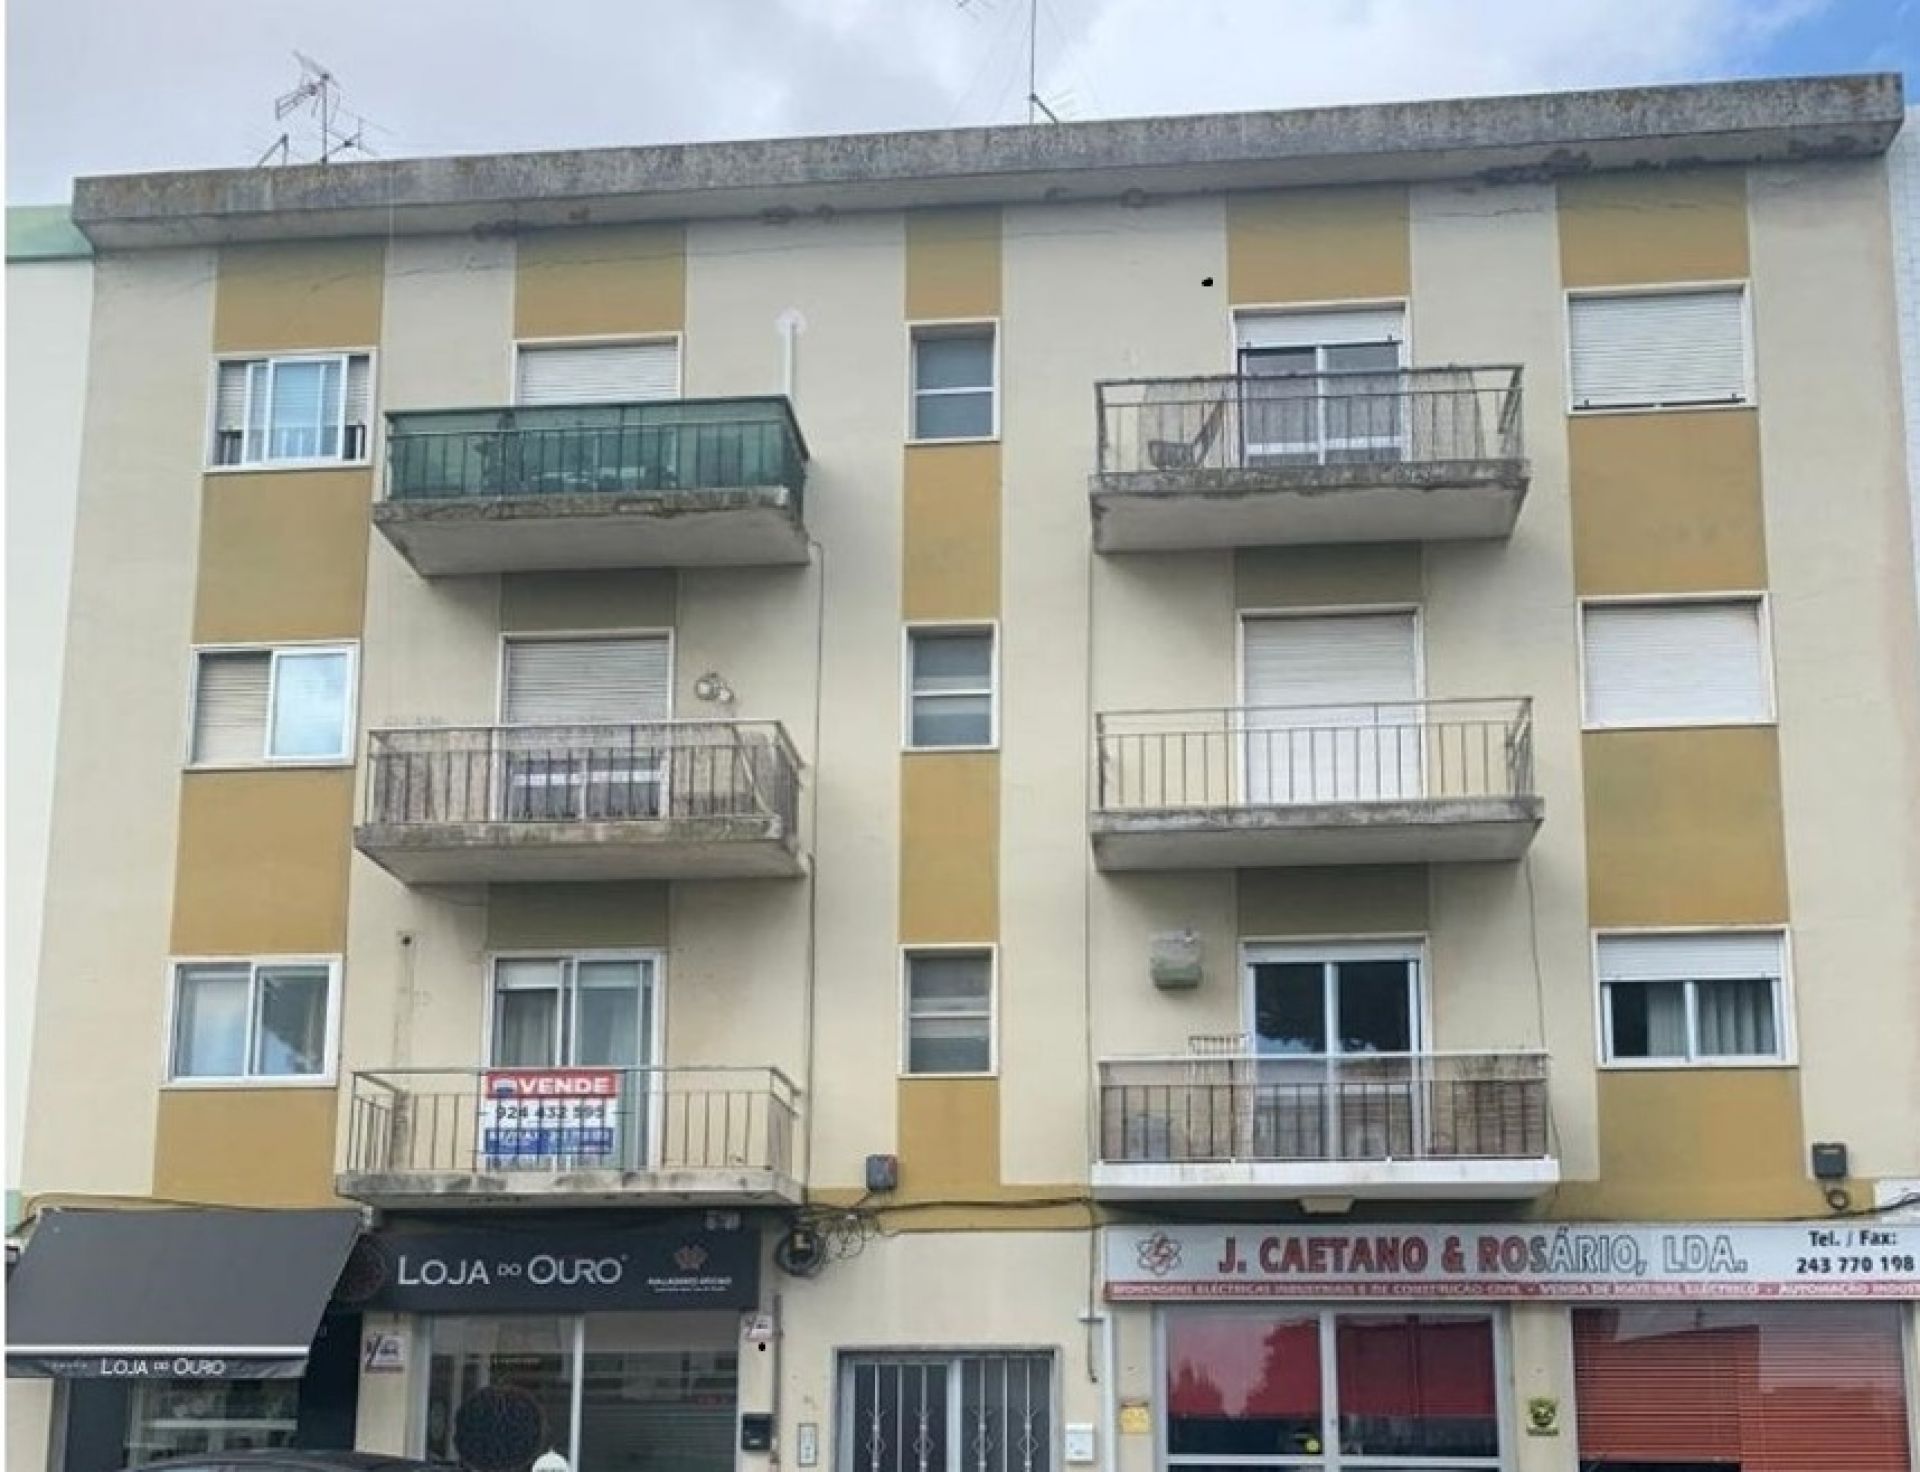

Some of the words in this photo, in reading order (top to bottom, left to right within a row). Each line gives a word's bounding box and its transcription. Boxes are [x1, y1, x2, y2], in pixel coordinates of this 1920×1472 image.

[519, 1077, 610, 1095] VENDE
[1807, 1230, 1840, 1246] Tel.
[1218, 1236, 1247, 1273] J.
[1259, 1235, 1429, 1274] CAETANO
[1441, 1235, 1465, 1273] &
[1477, 1226, 1647, 1276] ROSÁRIO,
[1662, 1235, 1748, 1273] LDA.
[1797, 1256, 1831, 1273] 243
[1837, 1256, 1873, 1273] 770
[1880, 1254, 1914, 1272] 198
